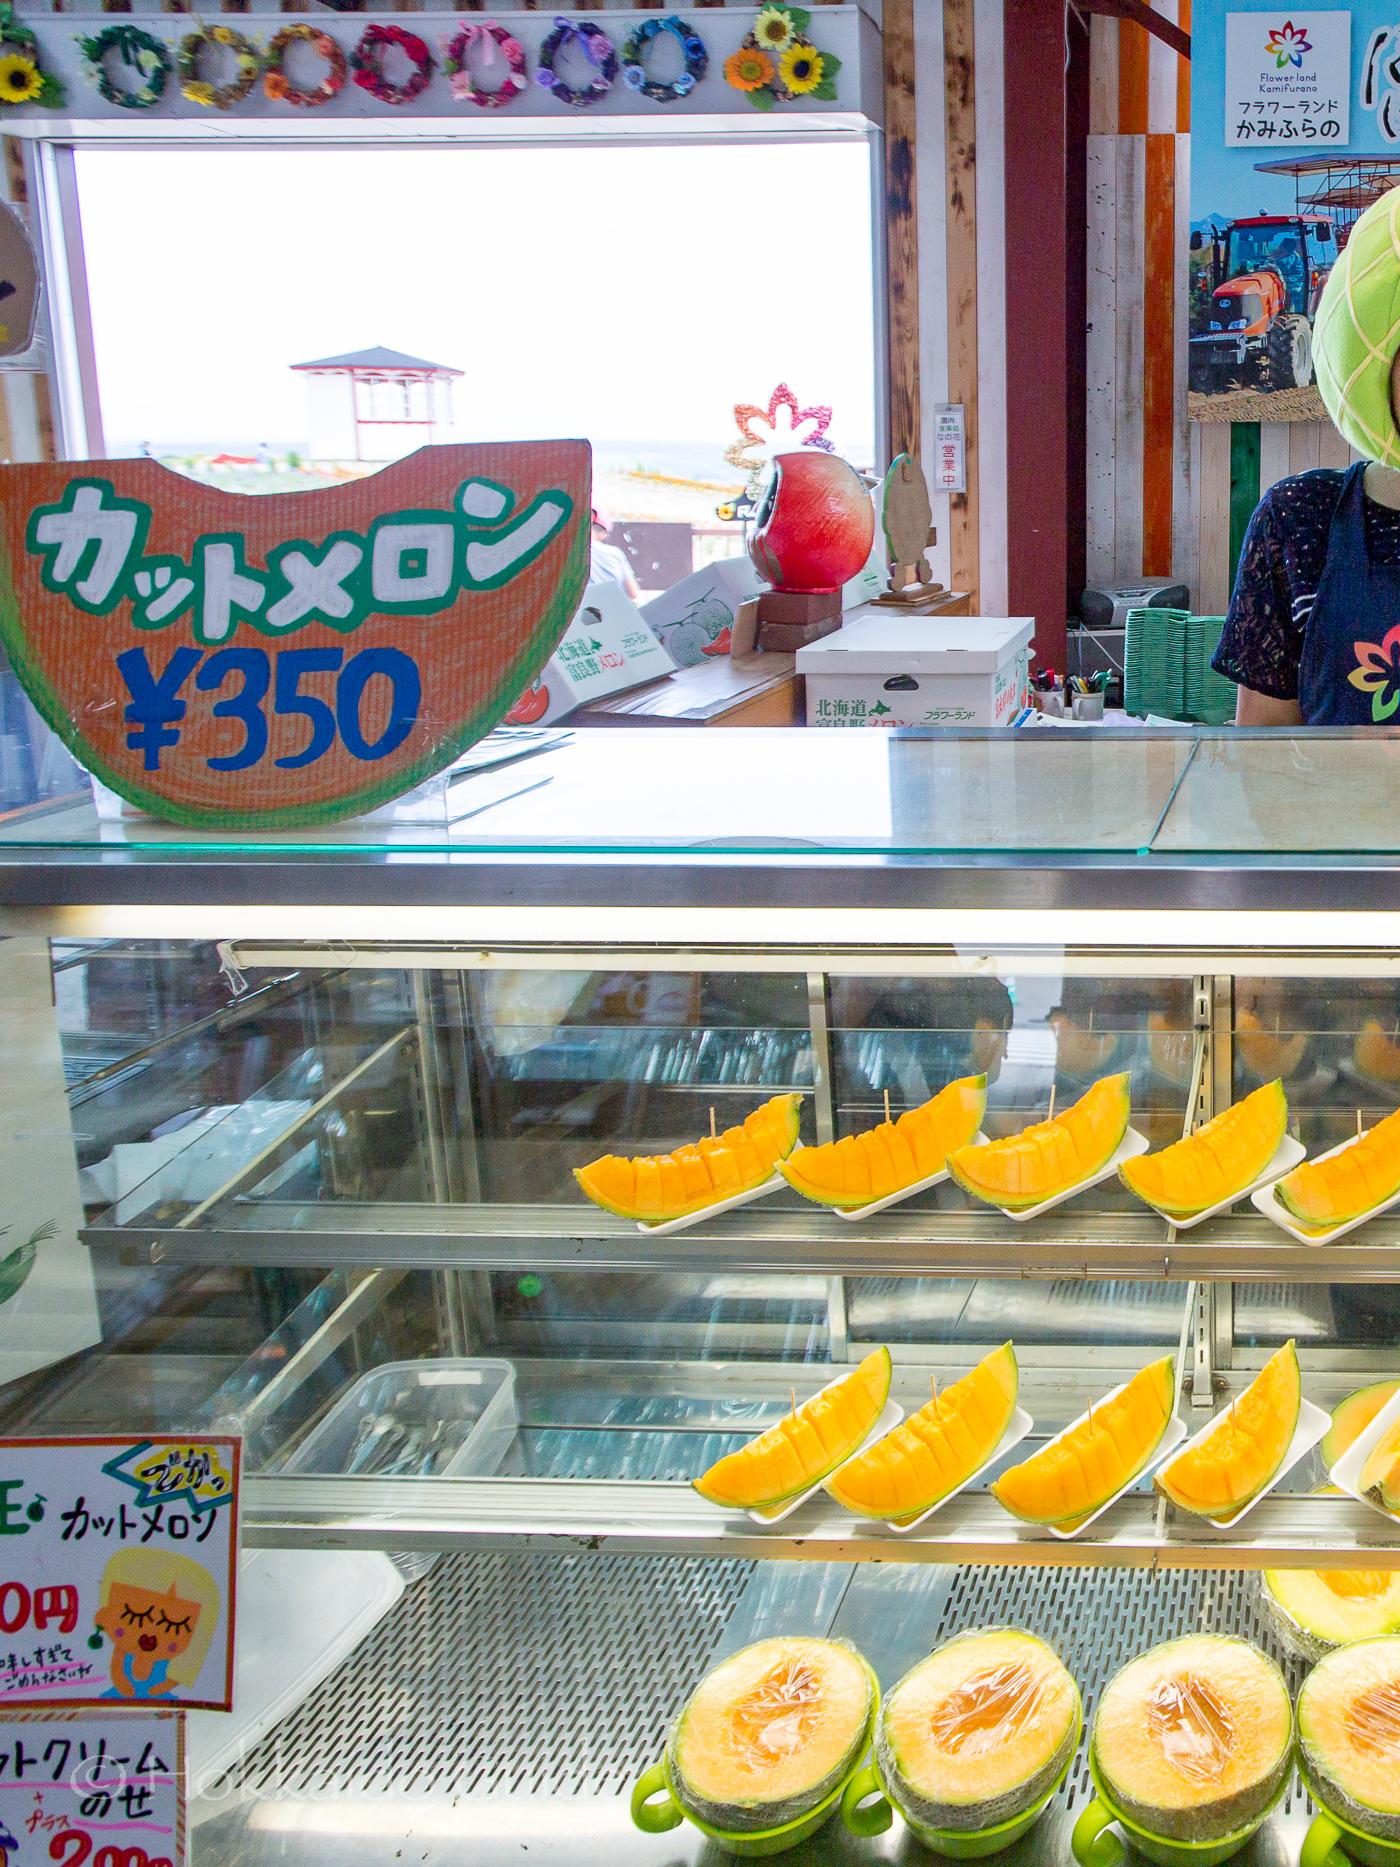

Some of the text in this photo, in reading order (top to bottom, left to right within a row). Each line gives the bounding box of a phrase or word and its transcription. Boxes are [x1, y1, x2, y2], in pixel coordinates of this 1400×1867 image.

[1259, 83, 1318, 93] Kamifurano
[1238, 99, 1339, 114] フラワーランド
[1236, 118, 1340, 139] かみふらの
[942, 444, 956, 487] 営業中
[31, 480, 569, 641] カットメロン
[116, 646, 422, 772] ¥350
[815, 699, 867, 717] 北海道
[924, 710, 976, 721] フラワーランド
[61, 1496, 217, 1543] カットメロン
[79, 1784, 153, 1819] のせ
